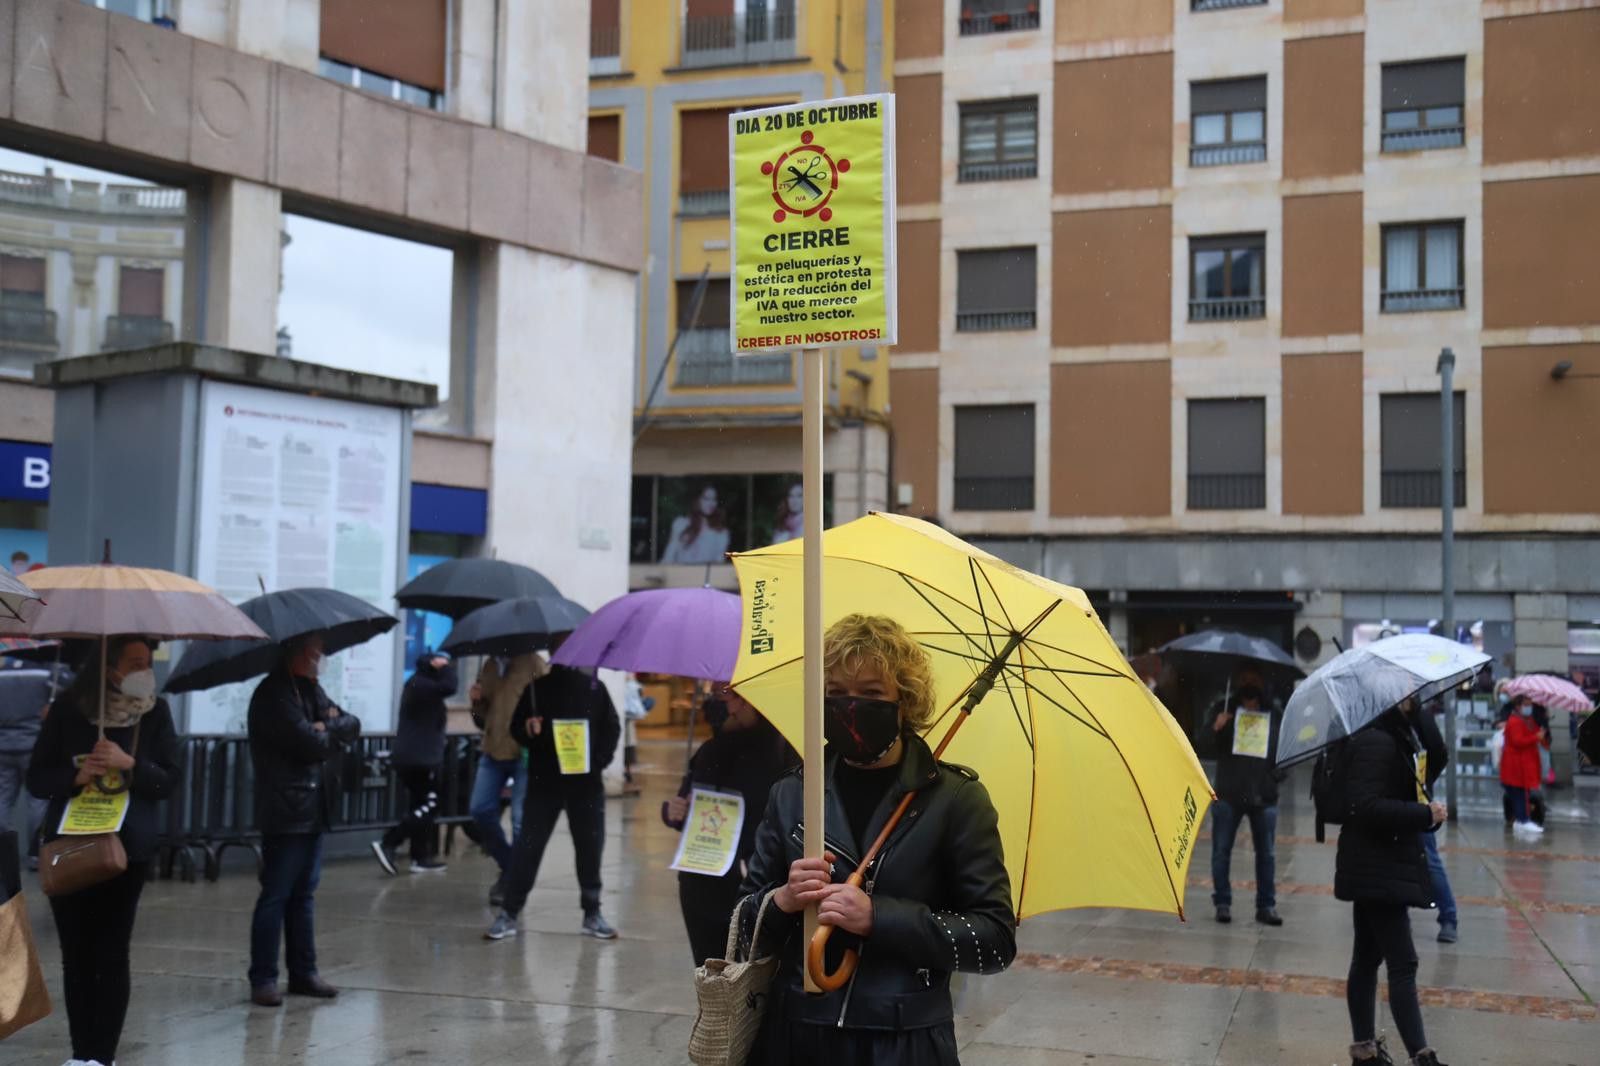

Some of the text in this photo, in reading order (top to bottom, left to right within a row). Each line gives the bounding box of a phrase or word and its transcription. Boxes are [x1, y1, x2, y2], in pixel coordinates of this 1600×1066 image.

[736, 102, 878, 135] DIA 20 DE OCTUBRE
[763, 227, 850, 253] CIERRE
[757, 254, 862, 273] en peluquerías y
[744, 267, 871, 286] estética en protesta
[745, 279, 871, 302] por la reducción del
[757, 295, 858, 311] IVA que merece
[760, 308, 855, 324] nuestro sector.
[737, 328, 881, 348] ¡CREER EN NOSOTROS!
